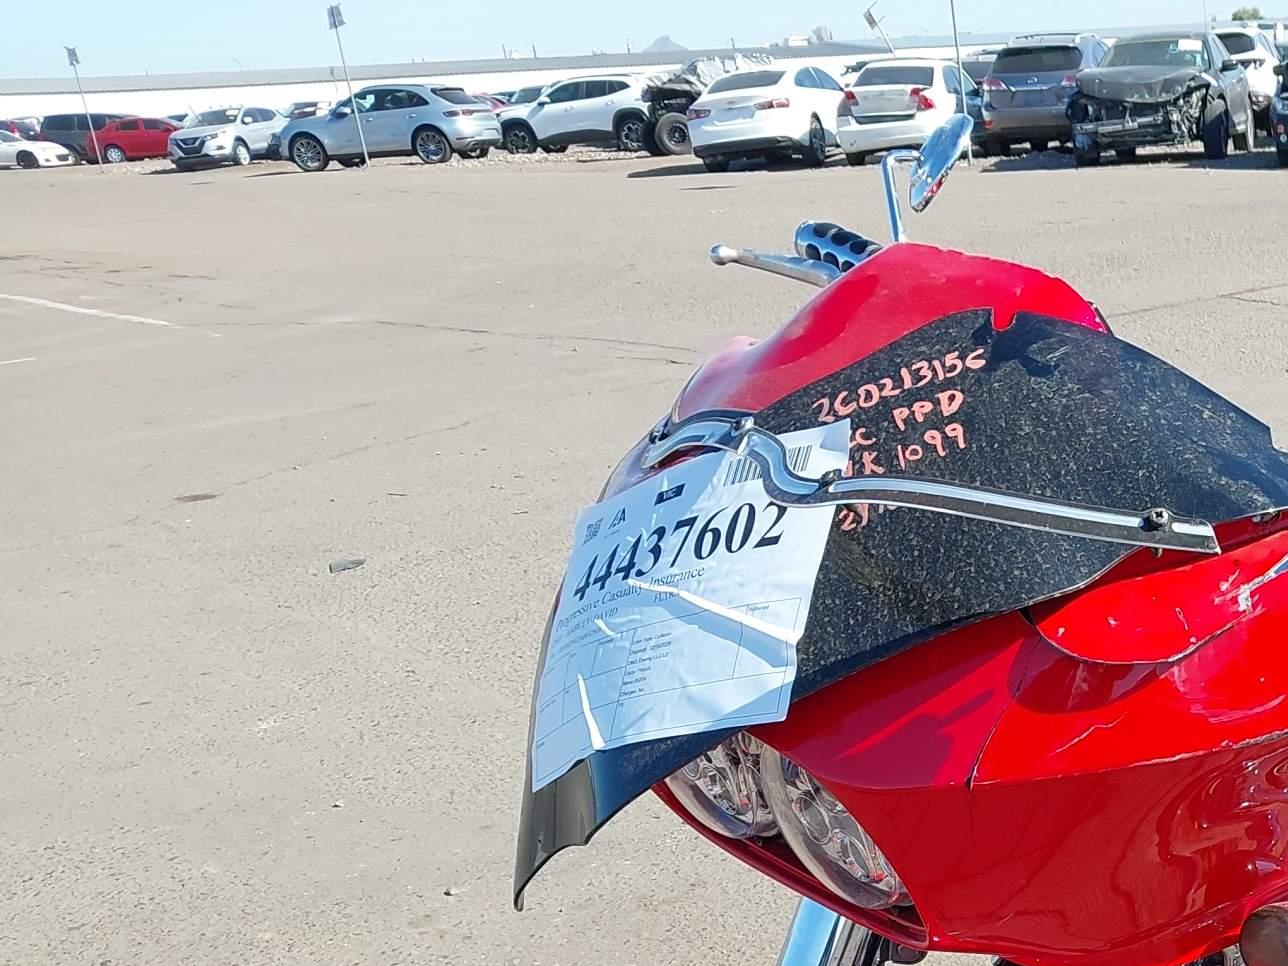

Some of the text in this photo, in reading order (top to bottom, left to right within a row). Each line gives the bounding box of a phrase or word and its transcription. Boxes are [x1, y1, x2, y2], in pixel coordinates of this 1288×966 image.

[892, 389, 964, 432] PPD
[897, 422, 966, 470] 1099
[573, 501, 788, 602] 44437602
[601, 583, 642, 606] Casualty
[649, 567, 705, 588] Insurance
